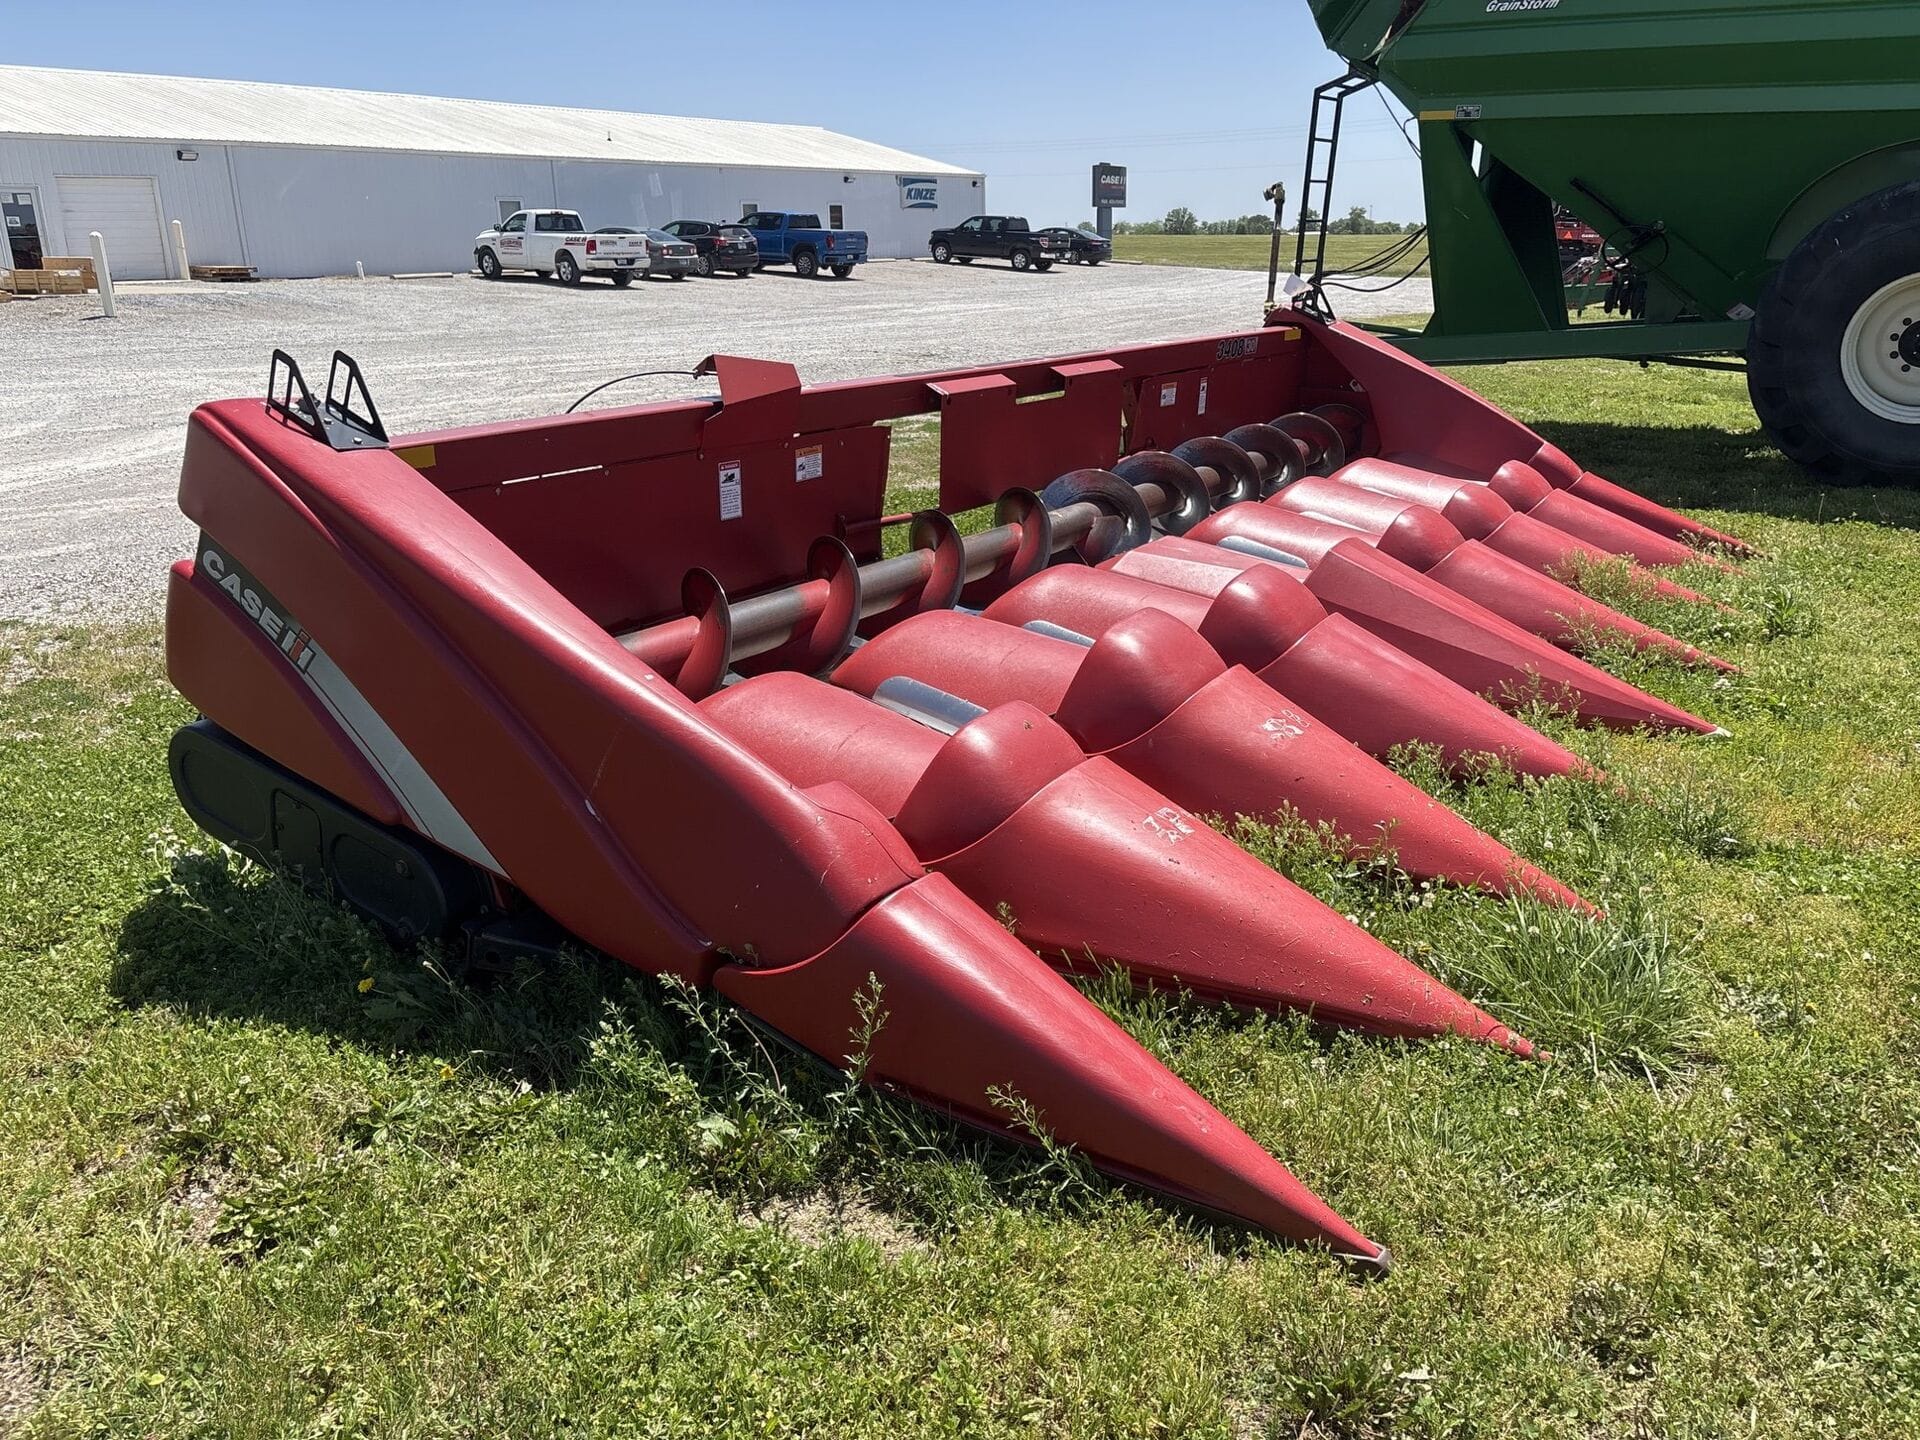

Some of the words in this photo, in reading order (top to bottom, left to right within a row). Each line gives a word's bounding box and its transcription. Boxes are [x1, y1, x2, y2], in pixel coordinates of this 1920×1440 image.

[1486, 0, 1560, 12] GrainStorm
[1101, 175, 1120, 184] CASE
[906, 187, 937, 200] KINZE
[1217, 338, 1245, 360] 3408
[203, 550, 284, 640] CASE
